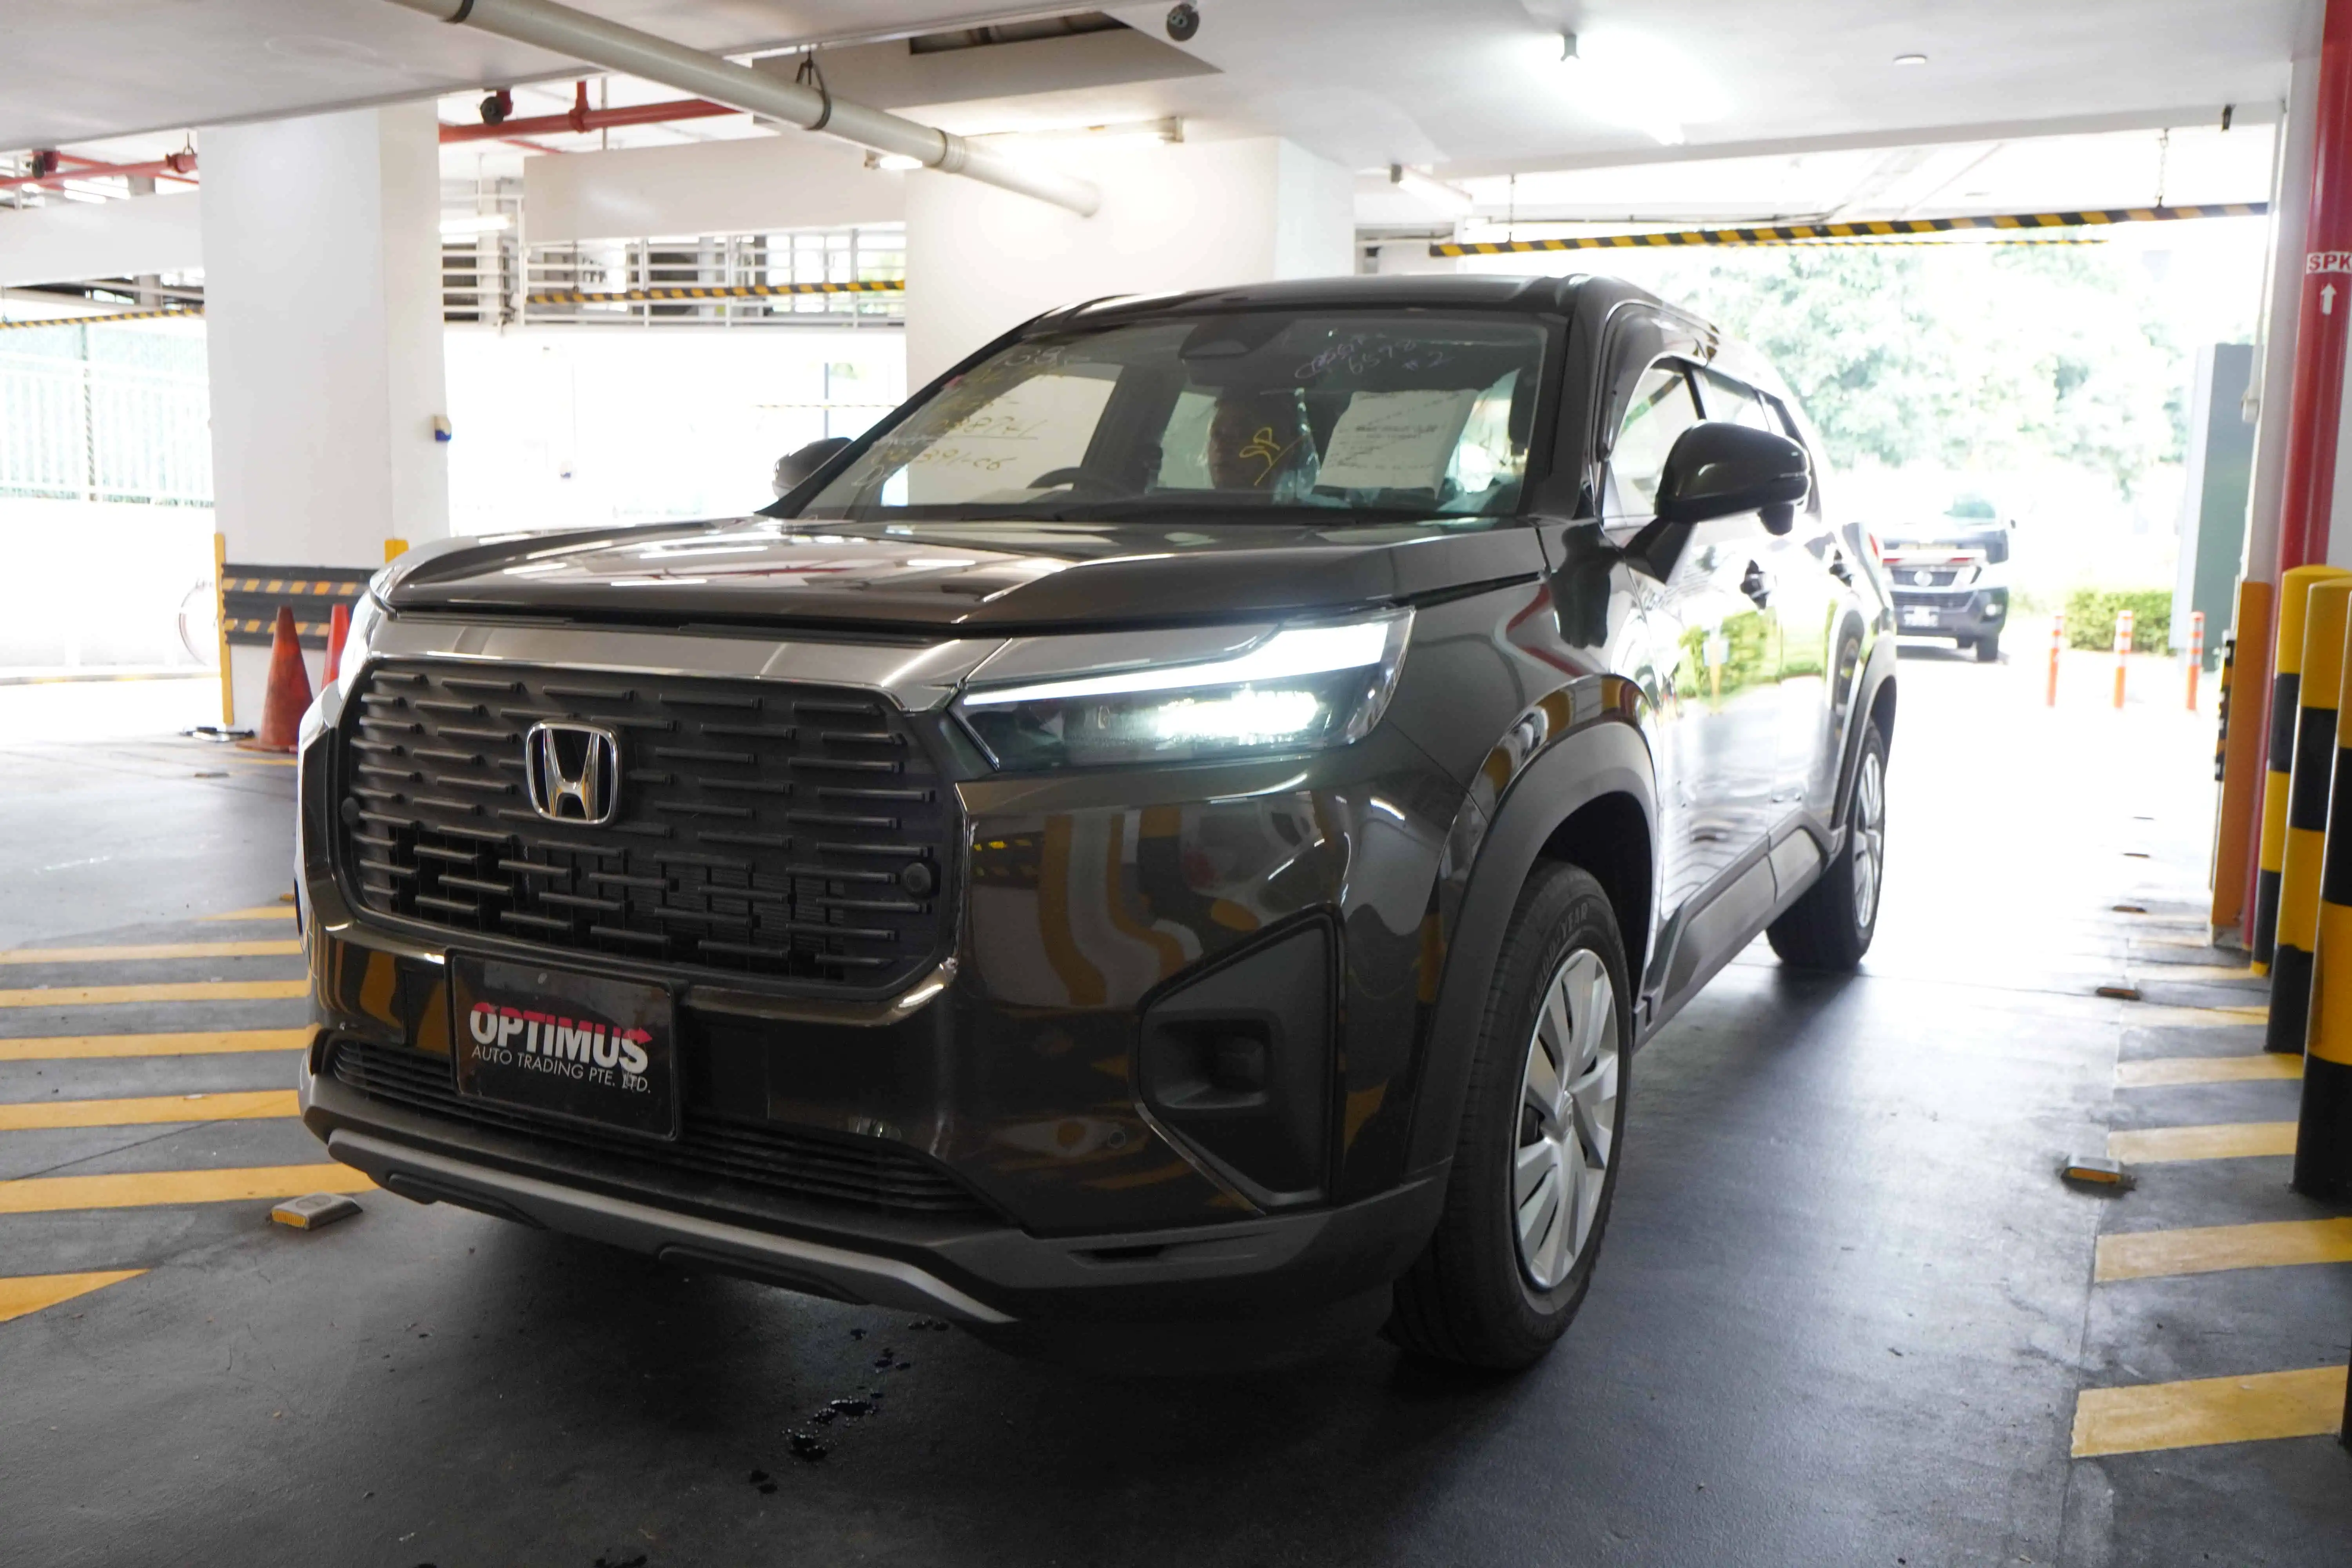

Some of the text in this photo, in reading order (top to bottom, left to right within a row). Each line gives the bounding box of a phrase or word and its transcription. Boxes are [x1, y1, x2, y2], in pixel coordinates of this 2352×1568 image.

[2308, 254, 2350, 271] SPK
[470, 1002, 652, 1074] OPTIMUS
[471, 1044, 651, 1094] AUTO TRADING PTE. LTD.
